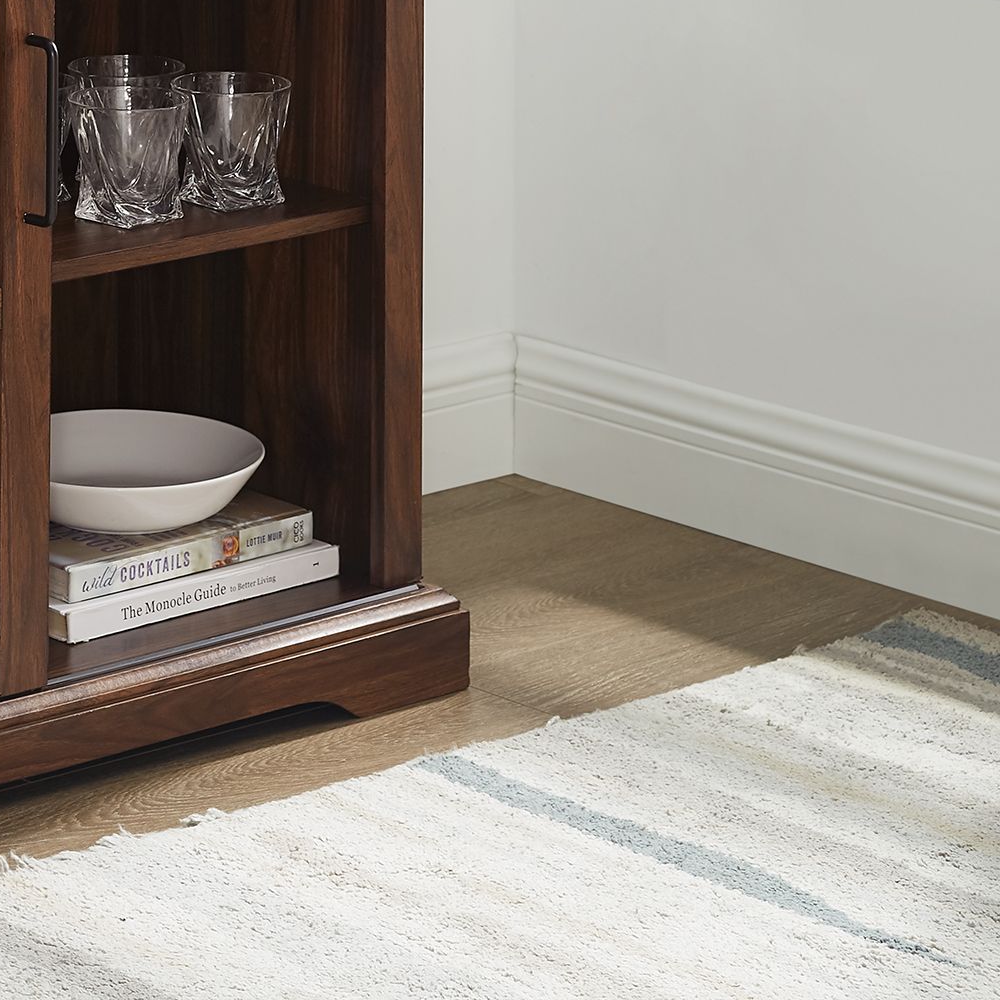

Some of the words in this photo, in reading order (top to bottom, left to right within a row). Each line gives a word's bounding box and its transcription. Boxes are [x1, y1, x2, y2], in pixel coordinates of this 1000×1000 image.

[246, 534, 266, 547] LOTTIE
[267, 530, 283, 543] MUIR
[82, 565, 118, 593] wild
[120, 551, 190, 583] COCKTAILS
[121, 605, 143, 620] The
[145, 591, 192, 615] Monocle
[194, 583, 227, 602] Guide
[229, 585, 237, 593] to
[237, 580, 257, 591] Better
[256, 575, 277, 587] Living
